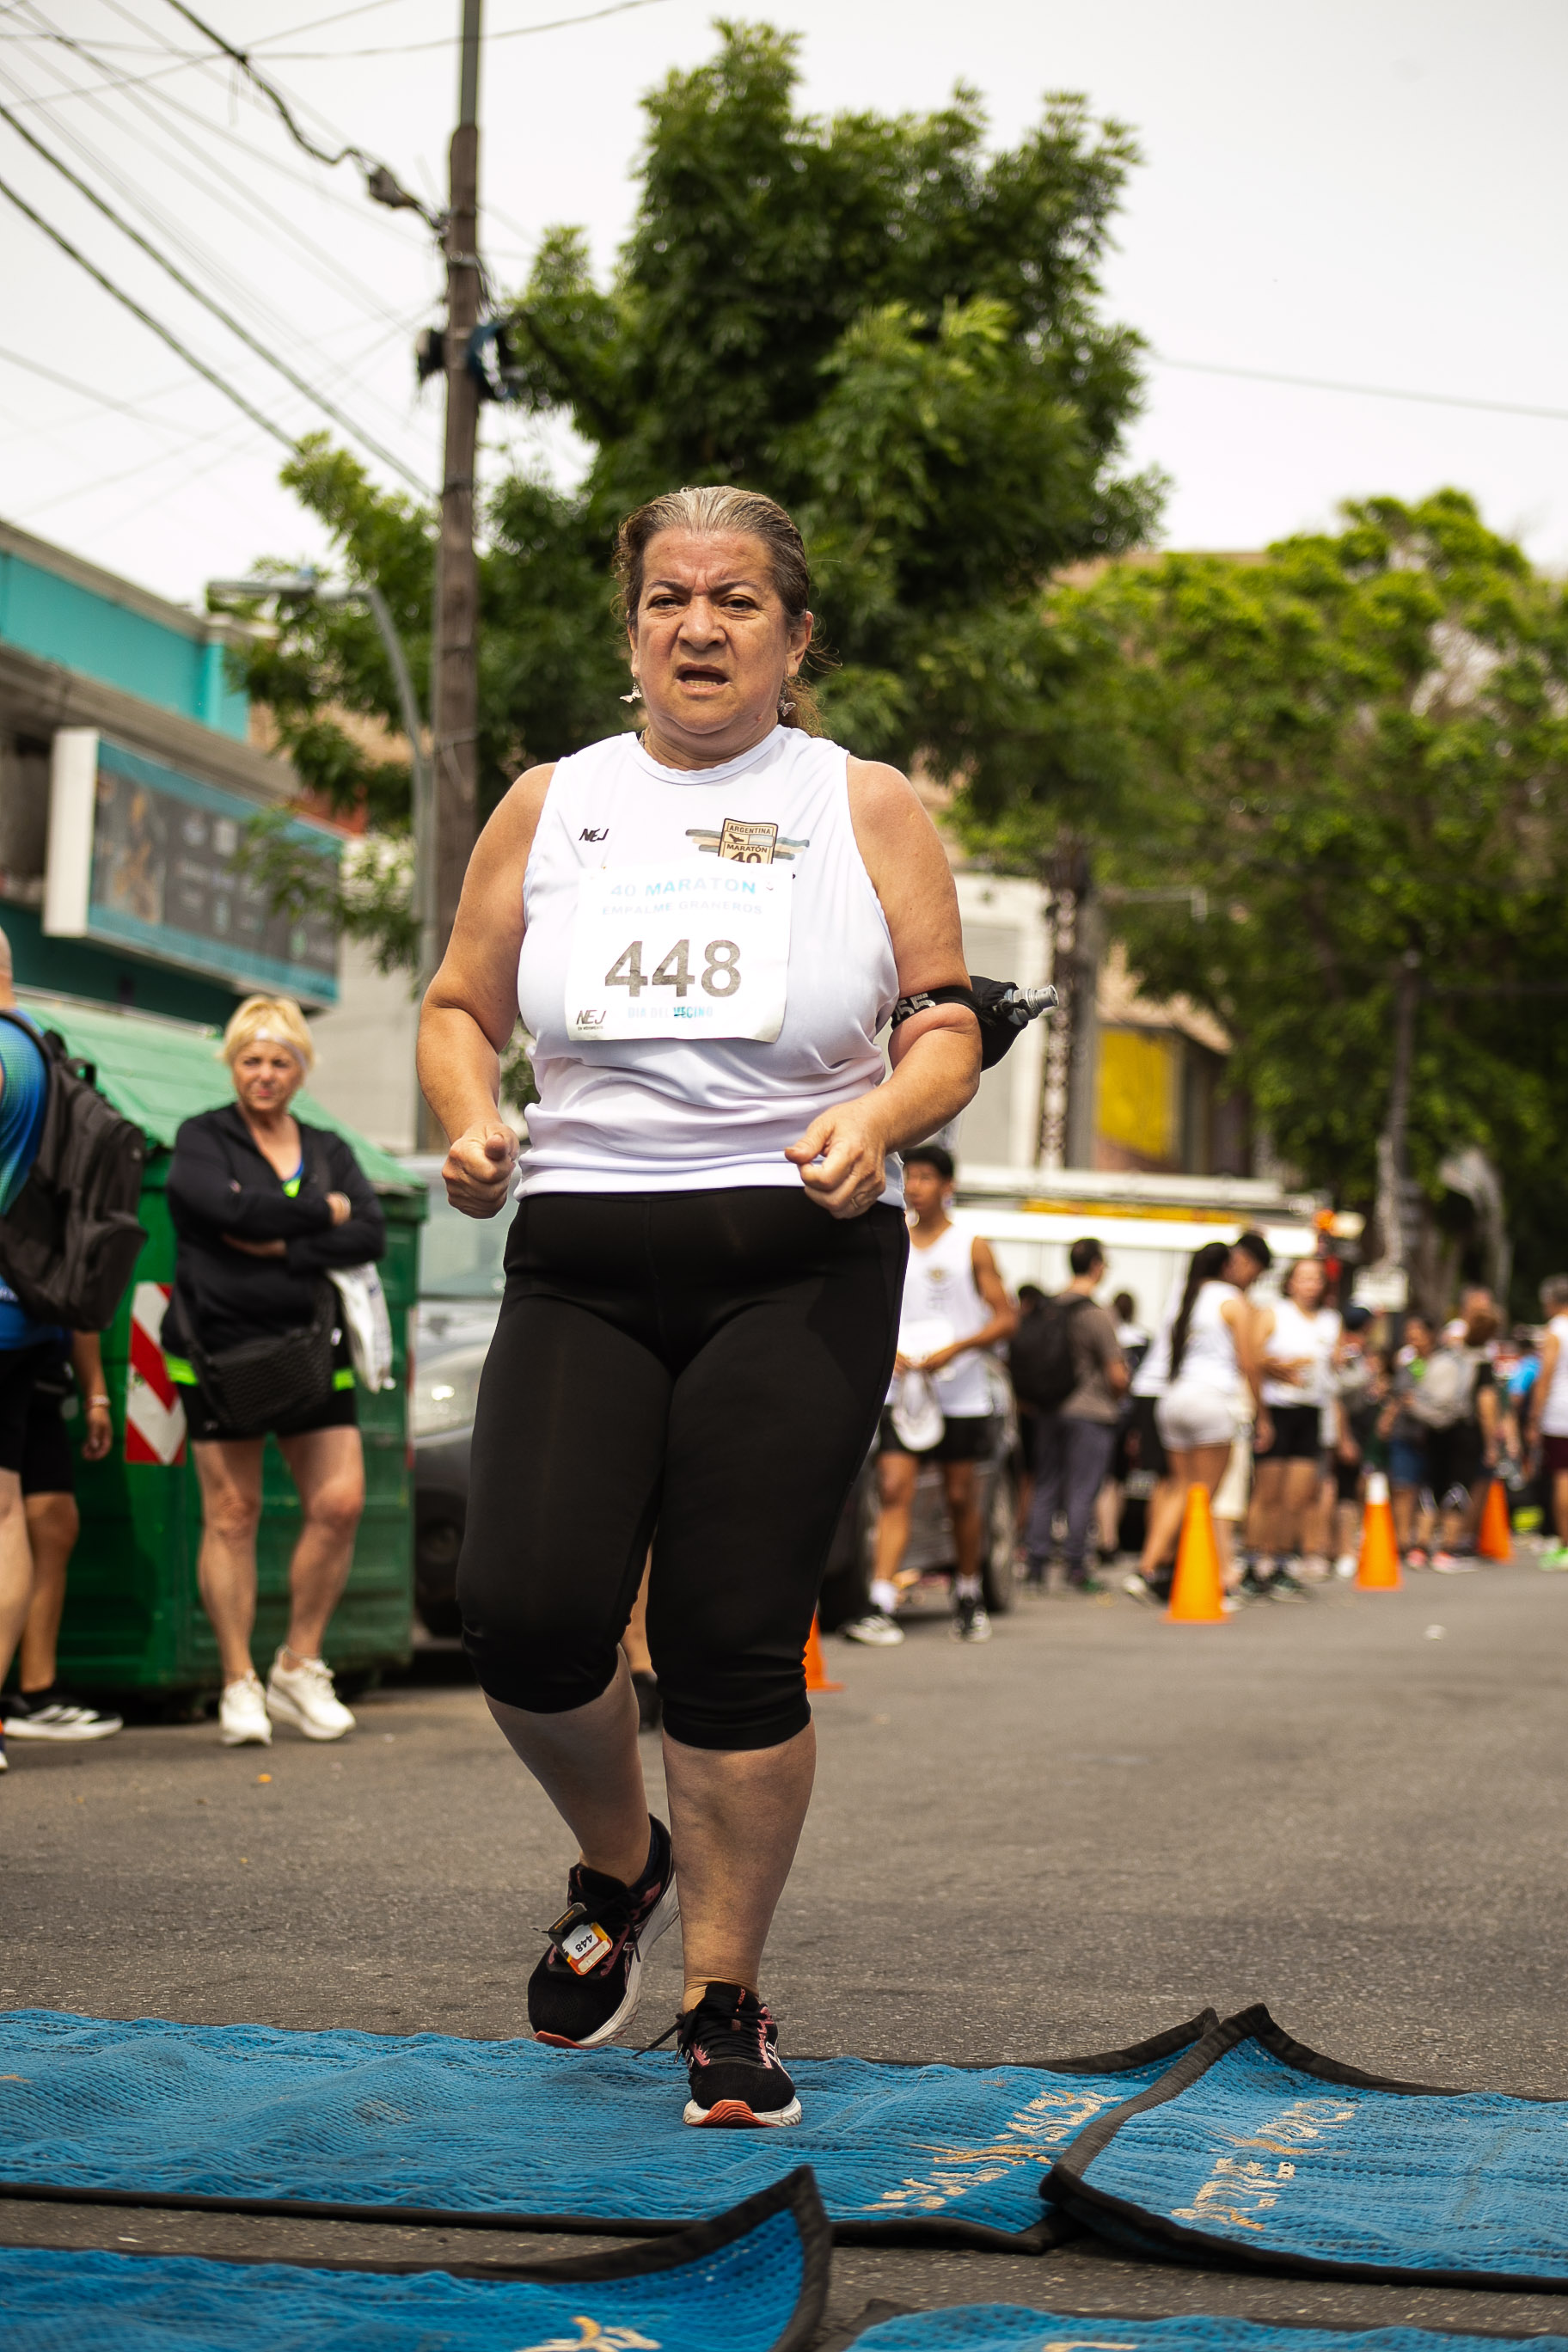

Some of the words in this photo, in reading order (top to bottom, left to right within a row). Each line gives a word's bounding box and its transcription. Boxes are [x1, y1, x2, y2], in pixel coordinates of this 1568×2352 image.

[579, 828, 609, 842] NEJ
[729, 824, 771, 835] ARGENTINA
[726, 843, 768, 853] MARATÓN
[610, 885, 636, 897] 40
[645, 877, 756, 897] MARATON
[602, 901, 673, 916] EMPALME
[678, 900, 763, 915] GRANEROS
[605, 940, 741, 997] 448
[576, 1009, 607, 1026] NEJ
[628, 1007, 646, 1019] DIA
[651, 1007, 669, 1019] DEL
[672, 1007, 714, 1020] VECINO
[575, 1934, 593, 1953] 448
